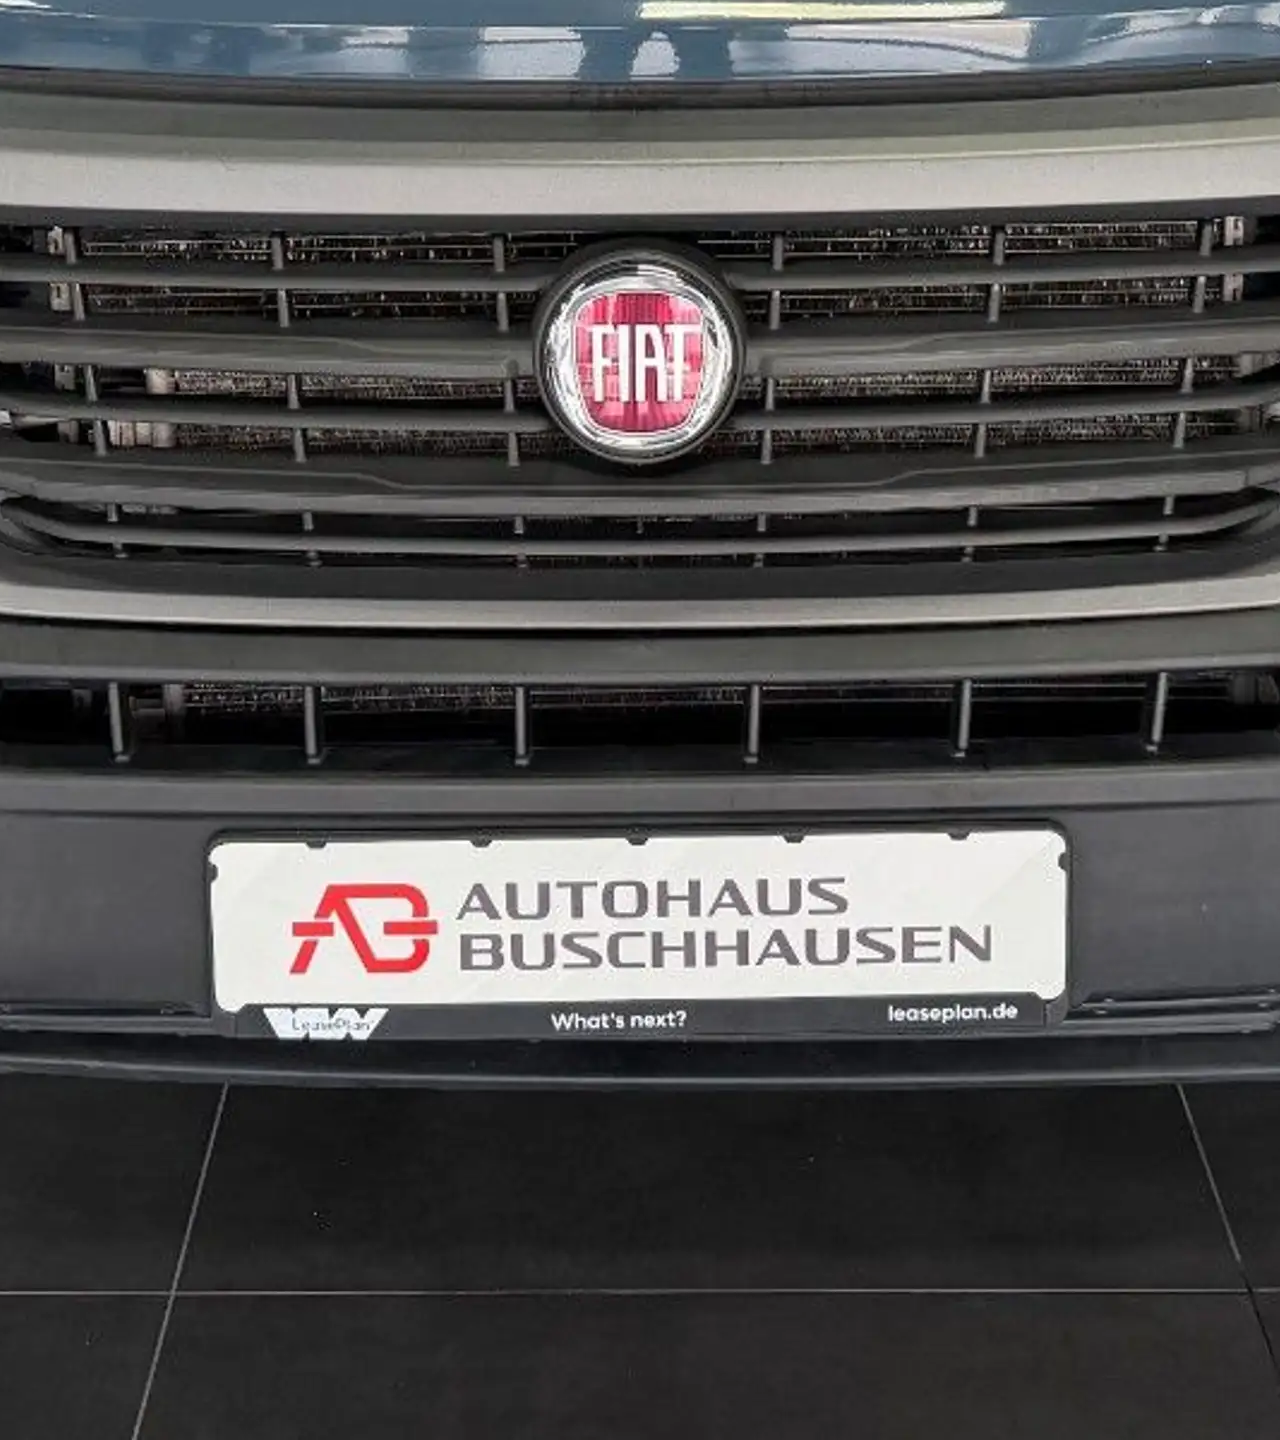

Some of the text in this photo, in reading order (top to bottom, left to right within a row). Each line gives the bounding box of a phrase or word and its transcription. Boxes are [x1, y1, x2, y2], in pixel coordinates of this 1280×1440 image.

[586, 323, 702, 403] FIAT
[456, 876, 849, 921] AUTOHAUS
[458, 924, 993, 972] BUSCHHAUSEN
[551, 1010, 688, 1031] What's next?
[887, 1004, 1019, 1025] leaseplan.de
